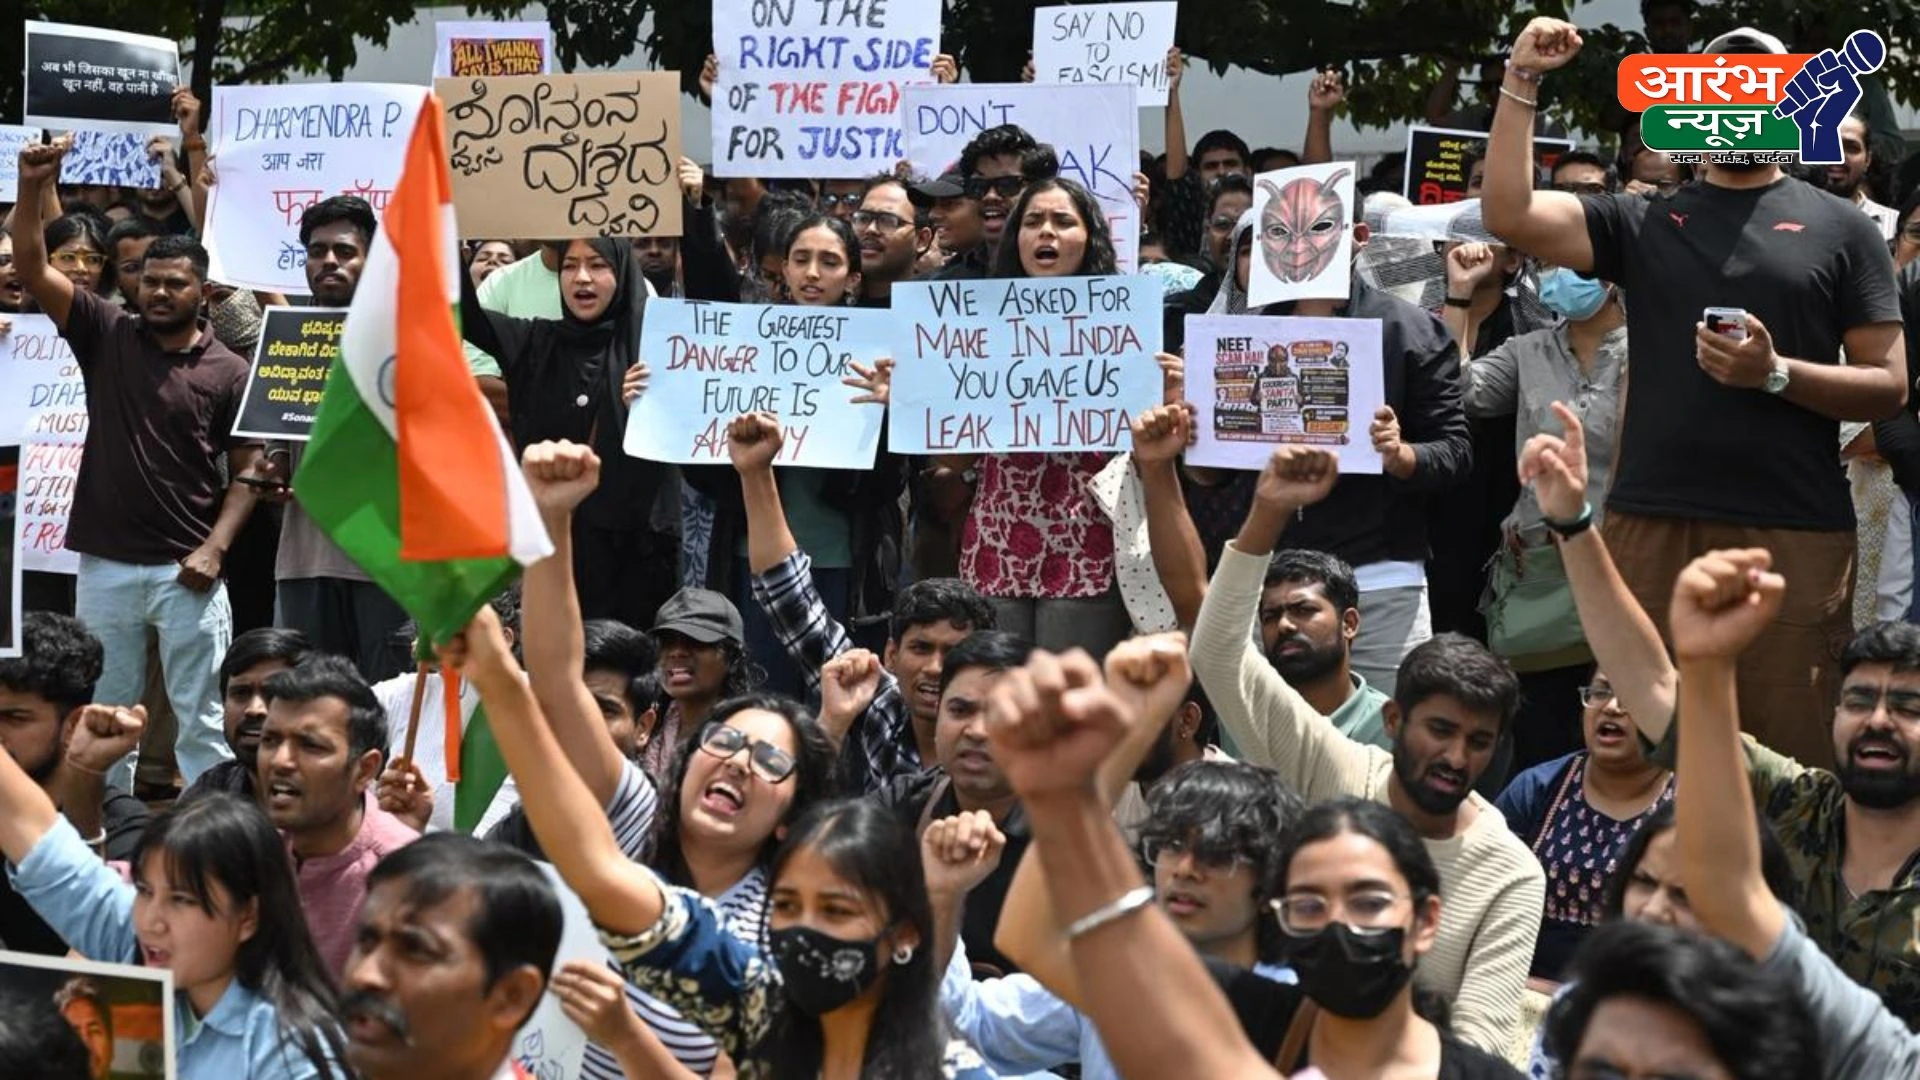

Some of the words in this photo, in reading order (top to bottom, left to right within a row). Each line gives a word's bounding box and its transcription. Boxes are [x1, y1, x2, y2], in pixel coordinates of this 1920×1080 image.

[752, 0, 795, 28] ON
[815, 0, 888, 28] THE
[1052, 12, 1095, 41] SAY
[1106, 12, 1144, 41] NO
[454, 43, 482, 73] ALL
[491, 41, 540, 61] WANNA
[502, 58, 541, 75] THAT
[739, 35, 849, 69] RIGHT
[853, 37, 933, 72] SIDE
[1085, 42, 1110, 63] TO
[41, 61, 60, 73] अब
[62, 60, 76, 74] भी
[78, 61, 115, 77] जिसका
[117, 66, 136, 81] खून
[62, 78, 82, 94] खून
[108, 80, 124, 94] वह
[126, 80, 149, 95] पानी
[150, 81, 159, 96] है
[728, 82, 760, 113] OF
[768, 81, 828, 114] THE
[837, 81, 900, 115] FIG
[235, 103, 373, 141] DHARMENDRA
[382, 102, 402, 138] P.
[917, 100, 1016, 136] DON'T
[728, 126, 784, 161] FOR
[798, 126, 904, 160] JUSTIC
[261, 152, 291, 171] आप
[296, 152, 325, 171] जरा
[928, 281, 978, 317] WE
[999, 281, 1076, 316] ASKED
[1087, 278, 1131, 314] FOR
[684, 301, 732, 336] THE
[758, 306, 849, 341] GREATEST
[915, 323, 990, 359] MAKE
[1006, 317, 1051, 357] IN
[1060, 315, 1142, 356] INDIA
[666, 335, 759, 372] DANGER
[771, 341, 798, 375] TO
[806, 341, 852, 377] OUR
[1217, 337, 1252, 351] NEET
[948, 361, 998, 400] YOU
[1006, 359, 1079, 399] GAVE
[1084, 358, 1121, 397] US
[703, 378, 781, 415] FUTURE
[789, 382, 820, 417] IS
[925, 406, 994, 450] LEAK
[1007, 402, 1041, 448] IN
[1052, 399, 1134, 448] INDIA
